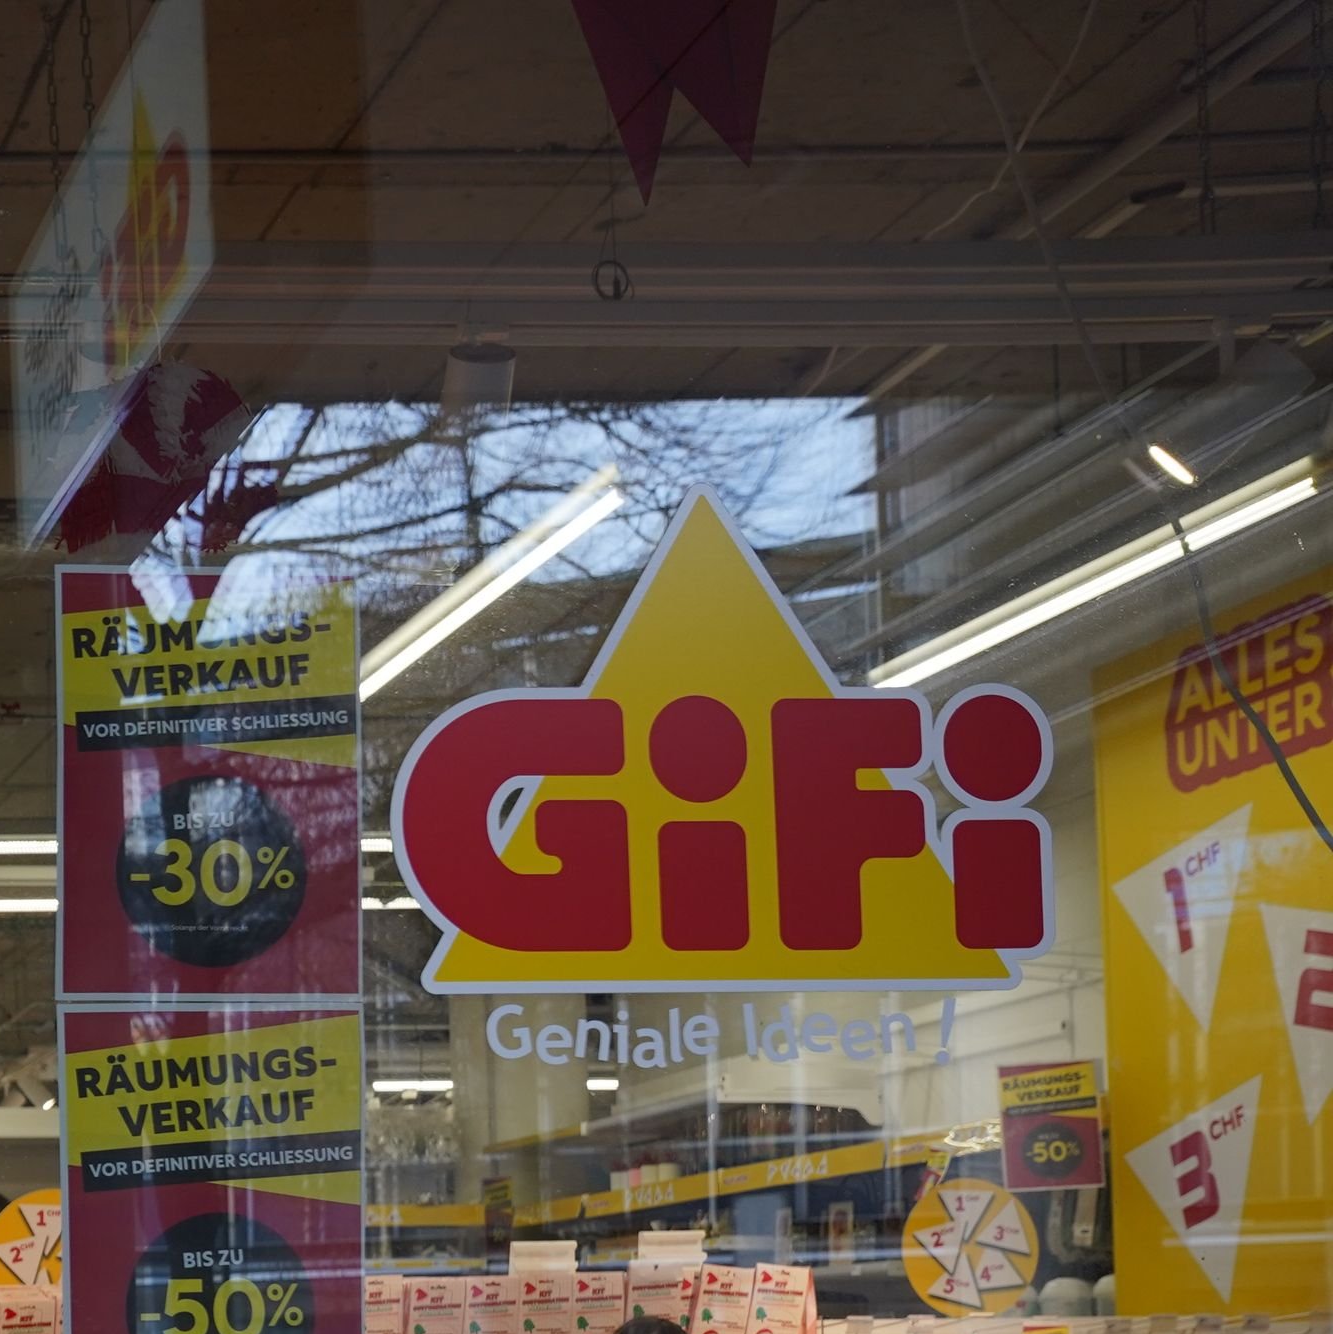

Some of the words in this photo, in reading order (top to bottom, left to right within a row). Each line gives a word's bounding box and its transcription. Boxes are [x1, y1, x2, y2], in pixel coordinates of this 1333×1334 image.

[112, 654, 309, 698] VERKAUF
[1175, 614, 1324, 724] ALLES
[83, 722, 121, 738] VOR
[124, 717, 227, 736] DEFINITIVER
[232, 710, 349, 731] SCHLIESSUNG
[1176, 681, 1325, 776] UNTER
[173, 812, 204, 831] BIS
[209, 811, 235, 829] ZU
[403, 694, 1045, 952] GiFi
[129, 838, 295, 907] -30%
[1163, 867, 1193, 954] 1
[1185, 841, 1221, 878] CHF
[487, 1003, 720, 1070] Geniale
[76, 1046, 336, 1098] RÄUMUNGS-
[1003, 1072, 1086, 1091] RÄUMUNGS-
[1017, 1085, 1080, 1102] VERKAUF
[118, 1090, 314, 1136] VERKAUF
[89, 1161, 128, 1177] VOR
[132, 1153, 236, 1174] DEFINITIVER
[239, 1146, 353, 1167] SCHLIESSUNG
[1026, 1141, 1081, 1163] -50%
[1170, 1129, 1220, 1230] 3
[1209, 1105, 1245, 1141] CHF
[956, 1196, 965, 1211] 1
[37, 1210, 46, 1226] 1
[931, 1232, 943, 1248] 2
[994, 1226, 1004, 1241] 3
[10, 1247, 23, 1263] 2
[183, 1250, 214, 1268] BIS
[218, 1249, 244, 1266] ZU
[943, 1278, 955, 1294] 5
[980, 1266, 991, 1281] 4
